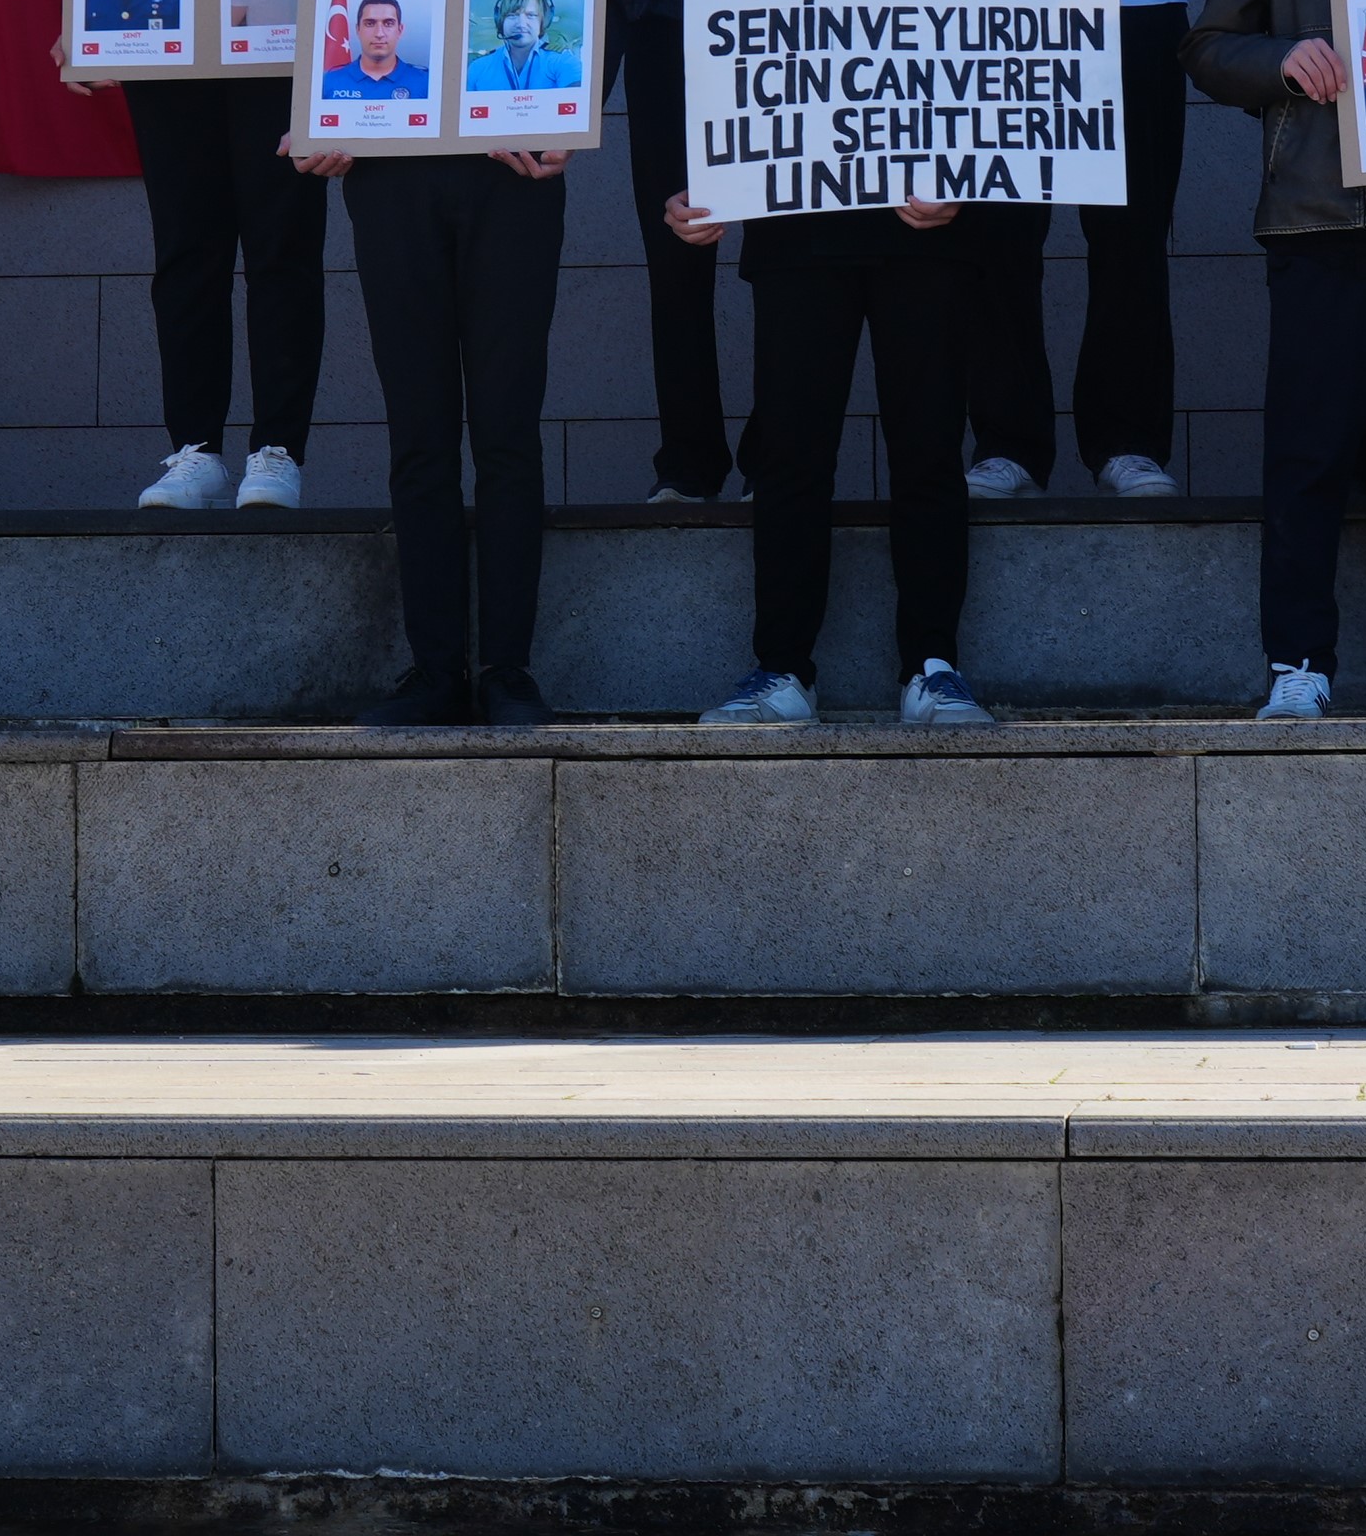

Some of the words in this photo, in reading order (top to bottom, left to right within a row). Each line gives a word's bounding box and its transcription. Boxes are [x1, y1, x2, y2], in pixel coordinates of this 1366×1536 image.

[123, 32, 142, 40] ŞEHİT
[858, 6, 919, 51] VE
[924, 6, 1105, 52] YURDUN
[513, 95, 534, 103] ŞEHİT
[735, 52, 831, 115] İÇİN
[840, 57, 934, 101] CAN
[940, 58, 1081, 102] VEREN
[705, 112, 804, 167] ULU
[833, 100, 1115, 163] ŞEHİTLERİNİ
